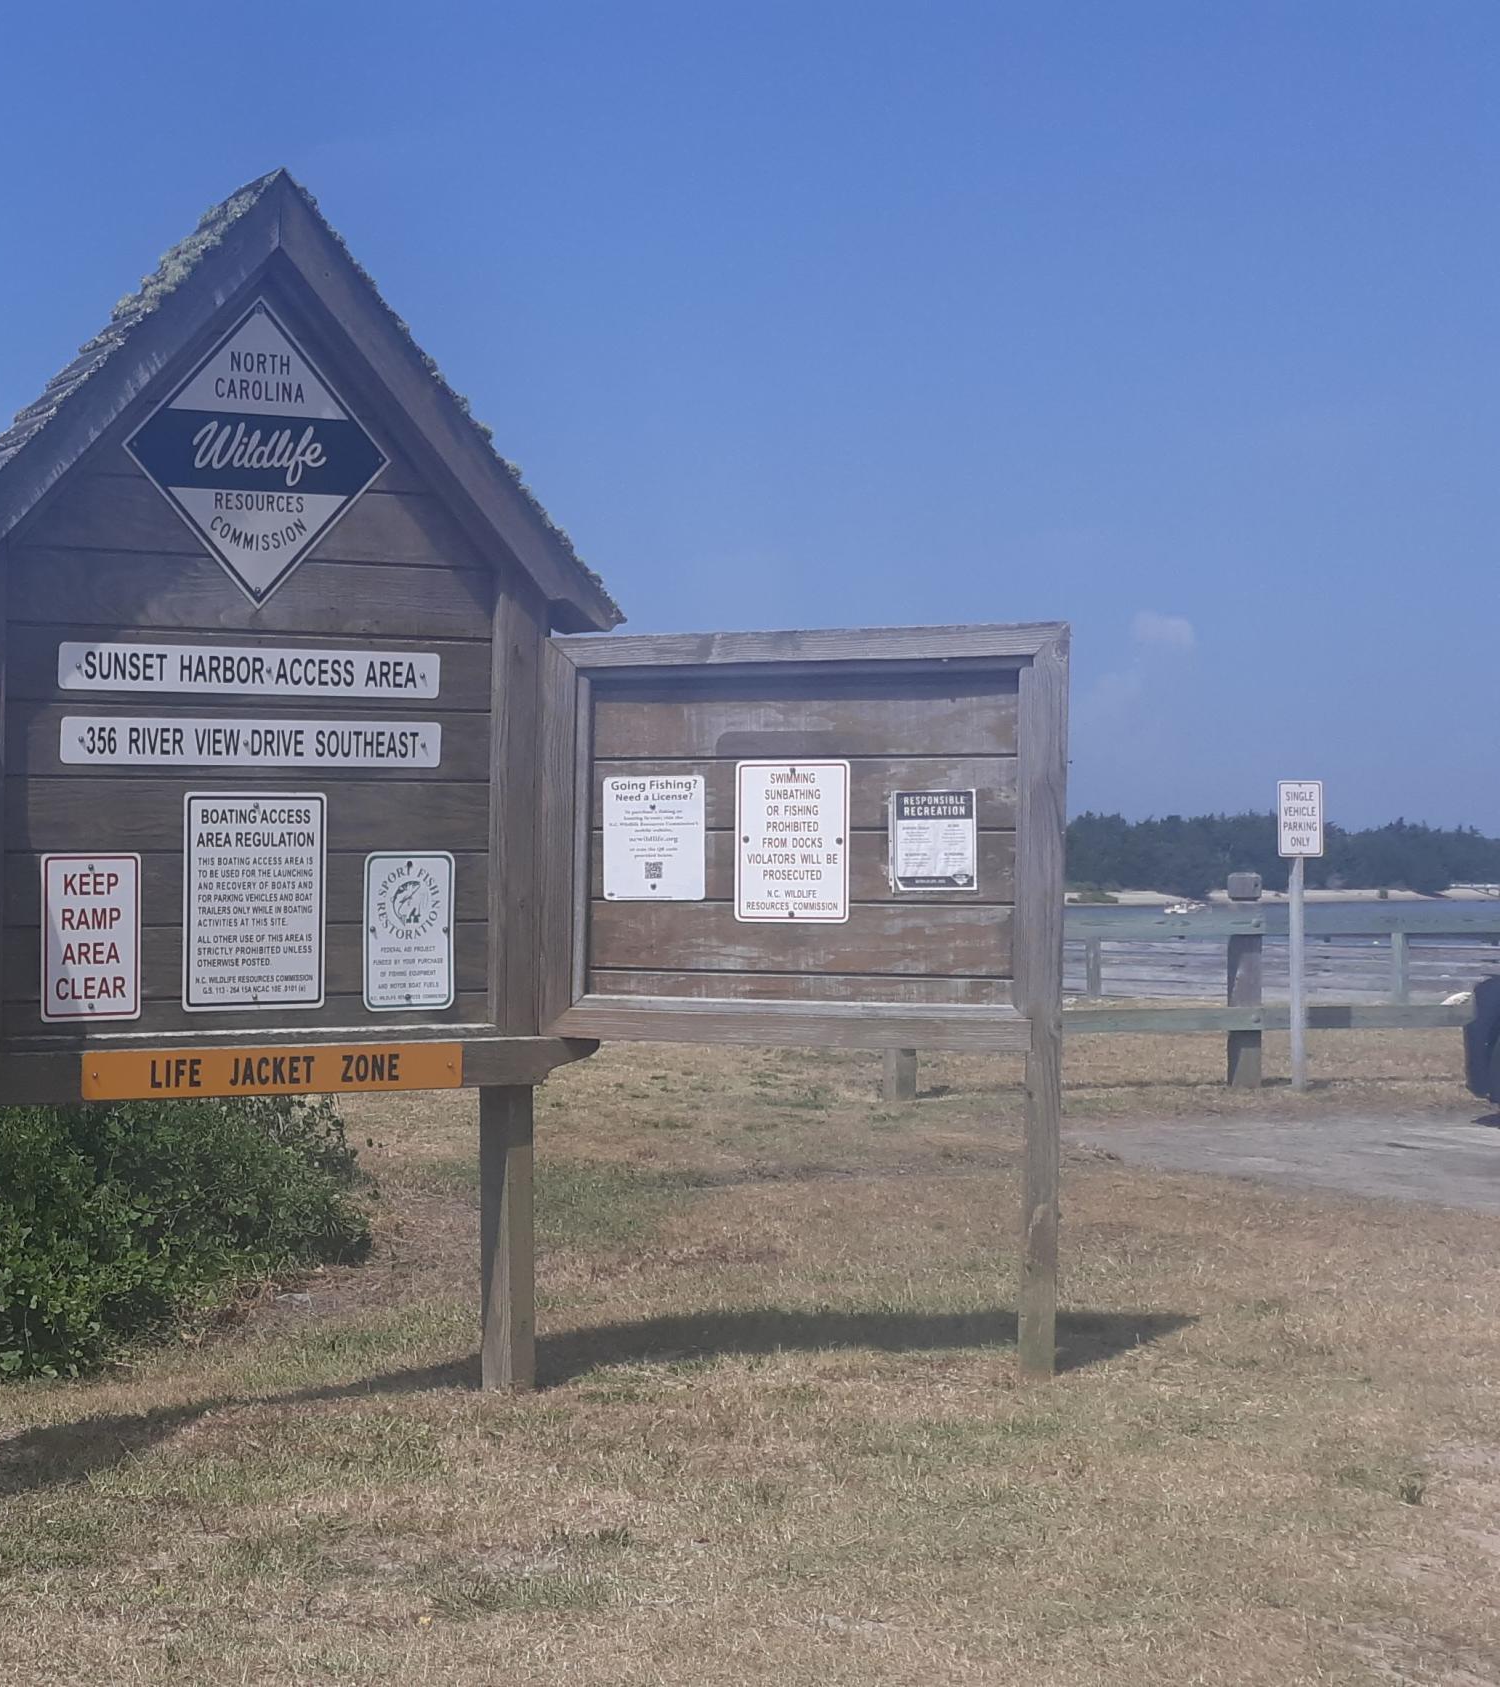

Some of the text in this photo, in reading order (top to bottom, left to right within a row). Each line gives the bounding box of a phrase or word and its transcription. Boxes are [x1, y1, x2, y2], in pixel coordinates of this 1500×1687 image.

[230, 351, 291, 375] NORTH
[215, 377, 305, 403] CAROLINA
[192, 420, 327, 487] Wildlife
[214, 492, 304, 513] RESOURCES
[210, 515, 307, 551] COMMISSION
[84, 651, 417, 689] SUNSET HARBOR ACCESS AREA
[86, 726, 419, 758] 356 RIVER VIEW DRIVE SOUTHEAST
[770, 773, 816, 784] SWIMMING
[611, 779, 697, 792] Going Fishing?
[652, 792, 693, 801] License?
[764, 789, 821, 800] SUNBATHING
[903, 795, 966, 805] RESPONSIBLE
[1285, 791, 1314, 801] SINGLE
[201, 808, 311, 824] BOATING ACCESS
[766, 805, 819, 816] OR FISHING
[903, 806, 966, 816] RECREATION
[1284, 806, 1316, 816] VEHICLE
[766, 821, 819, 832] PROHIBITED
[1283, 821, 1317, 832] PARKING
[196, 831, 315, 848] AREA REGULATION
[762, 837, 823, 848] FROM DOCKS
[1290, 836, 1310, 847] ONLY
[198, 856, 313, 866] THIS BOATING ACCESS AREA IS
[747, 853, 838, 864] VIOLATORS WILL BE
[198, 868, 313, 878] TO BE USED FOR THE LAUNCHING
[763, 870, 822, 880] PROSECUTED
[63, 873, 119, 896] KEEP
[198, 881, 313, 890] AND RECOVERY OF BOATS AND
[378, 866, 440, 898] SPORT FISH
[198, 893, 313, 903] FOR PARKING VEHICLES AND BOAT
[784, 889, 817, 898] WILDLIFE
[198, 905, 313, 915] TRAILERS ONLY WHILE IN BOATING
[746, 902, 838, 911] RESOURCES COMMISSION
[61, 907, 121, 930] RAMP
[197, 918, 238, 927] ACTIVITIES
[240, 918, 249, 927] AT
[251, 918, 268, 926] THIS
[377, 900, 441, 940] RESTORATION
[197, 933, 312, 944] ALL OTHER USE OF THIS AREA IS
[61, 942, 120, 965] AREA
[197, 945, 312, 956] STRICTLY PROHIBITED UNLESS
[197, 958, 240, 968] OTHERWISE
[208, 976, 237, 984] WILDLIFE
[238, 975, 274, 983] RESOURCES
[275, 974, 313, 982] COMMISSION
[56, 976, 126, 1000] CLEAR
[149, 1053, 400, 1089] LIFE JACKET ZONE
